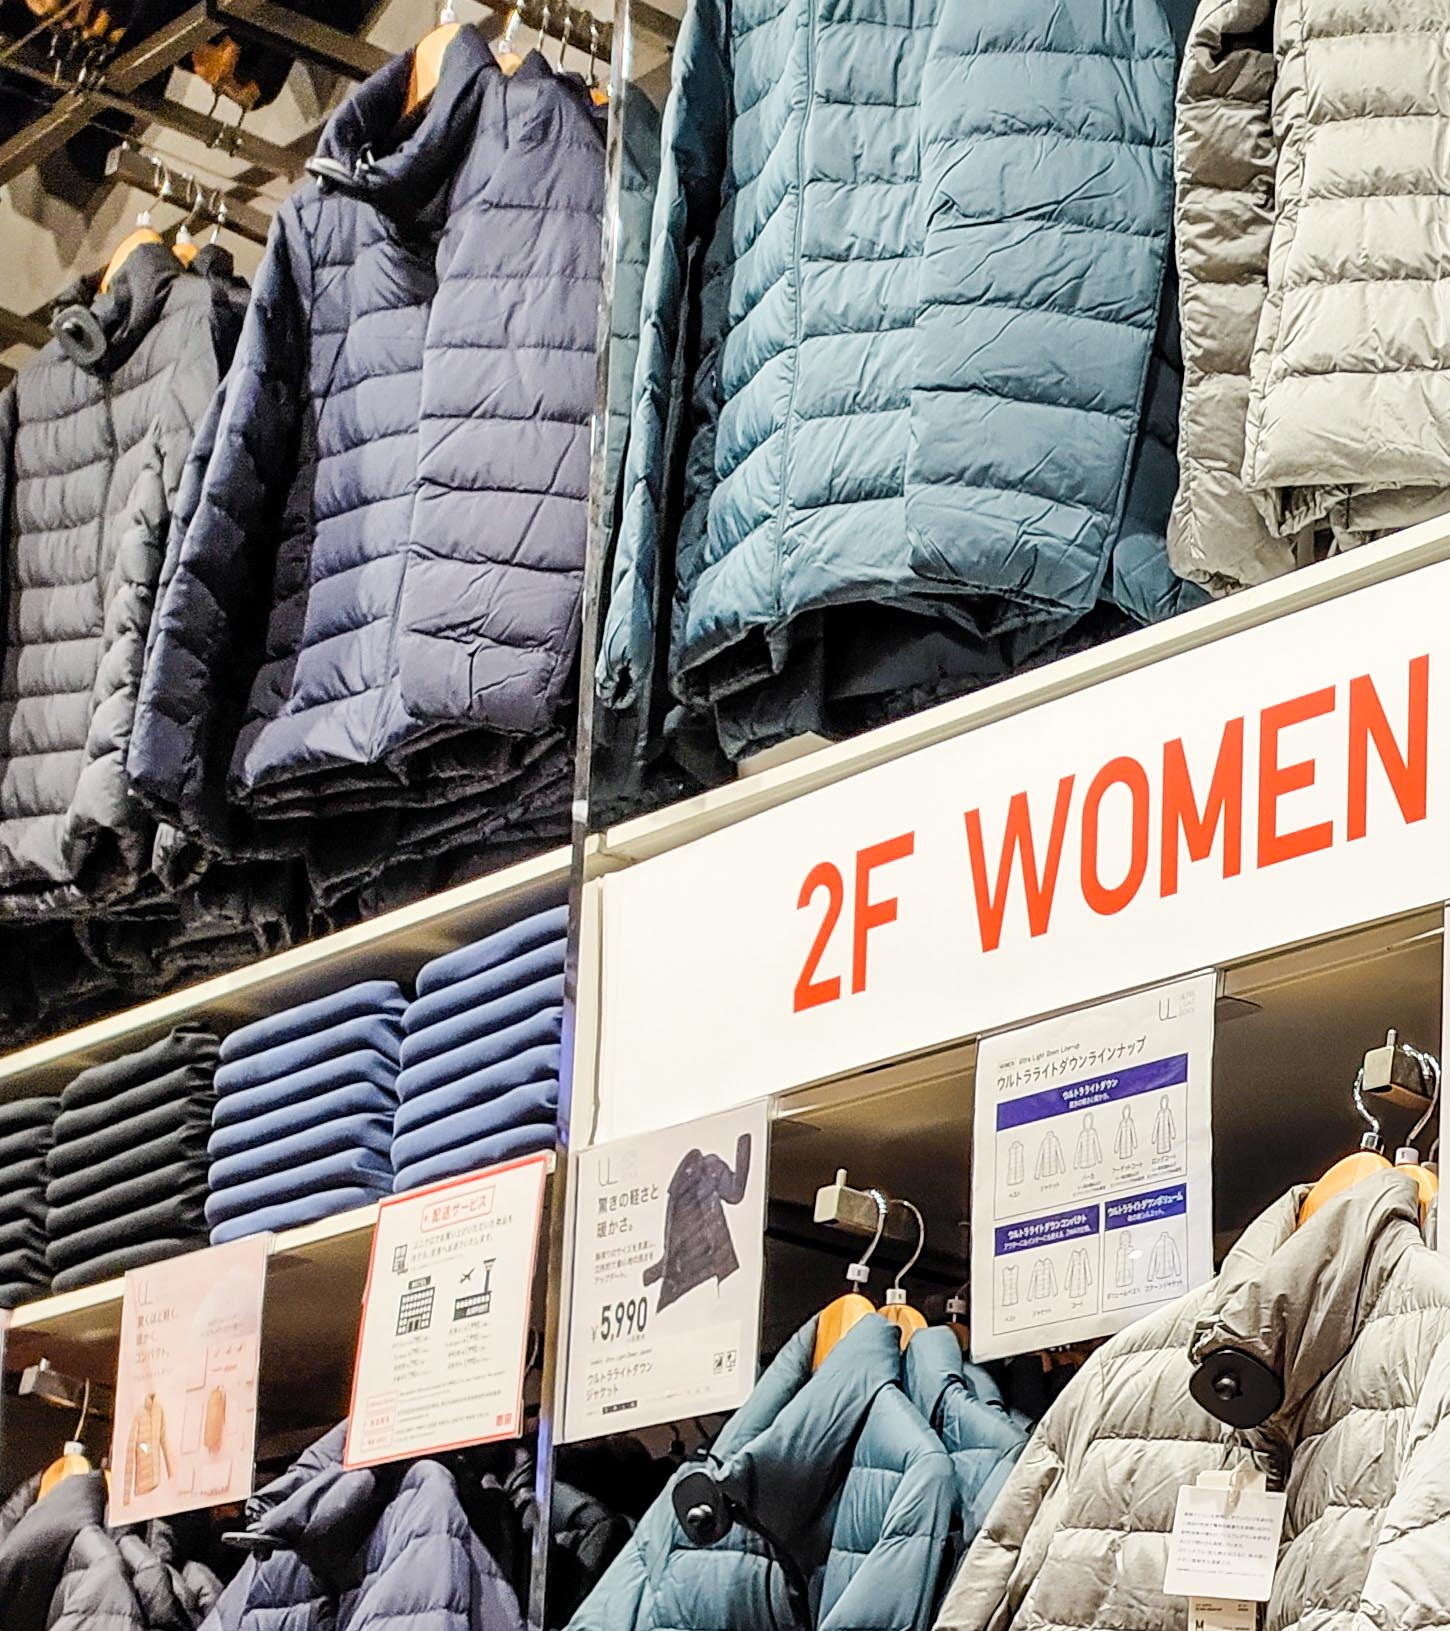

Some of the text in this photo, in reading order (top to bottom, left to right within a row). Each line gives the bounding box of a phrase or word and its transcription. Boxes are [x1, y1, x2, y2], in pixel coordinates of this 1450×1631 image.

[793, 653, 1430, 1013] 2F WOMEN
[997, 1035, 1147, 1092] ウルトラライトダウンラインナップ
[1195, 1620, 1204, 1631] M
